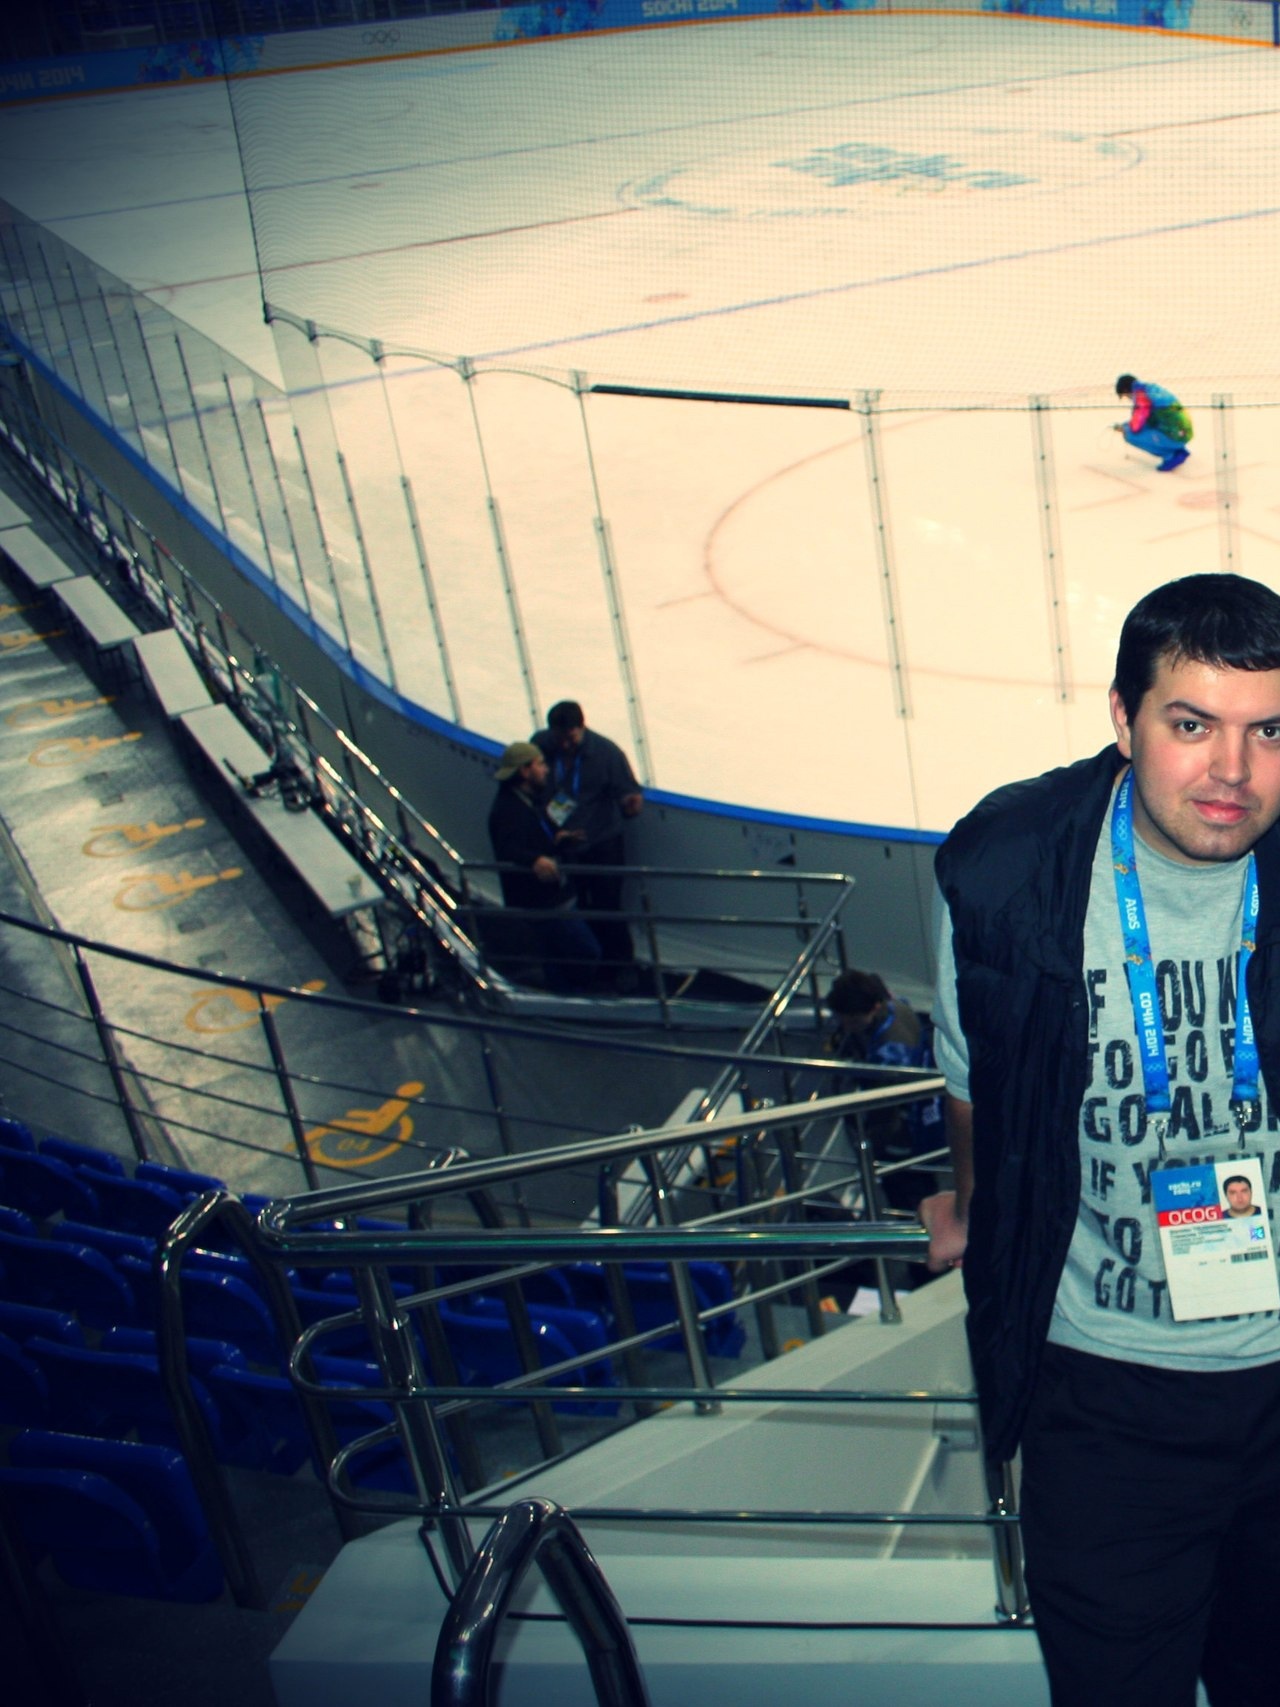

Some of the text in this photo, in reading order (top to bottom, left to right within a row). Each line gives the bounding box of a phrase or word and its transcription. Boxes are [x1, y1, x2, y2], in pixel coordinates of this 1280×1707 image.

[1086, 968, 1107, 1038] F
[1123, 959, 1206, 1032] OU
[1144, 1028, 1160, 1058] 2014
[1168, 1205, 1219, 1226] OCOG
